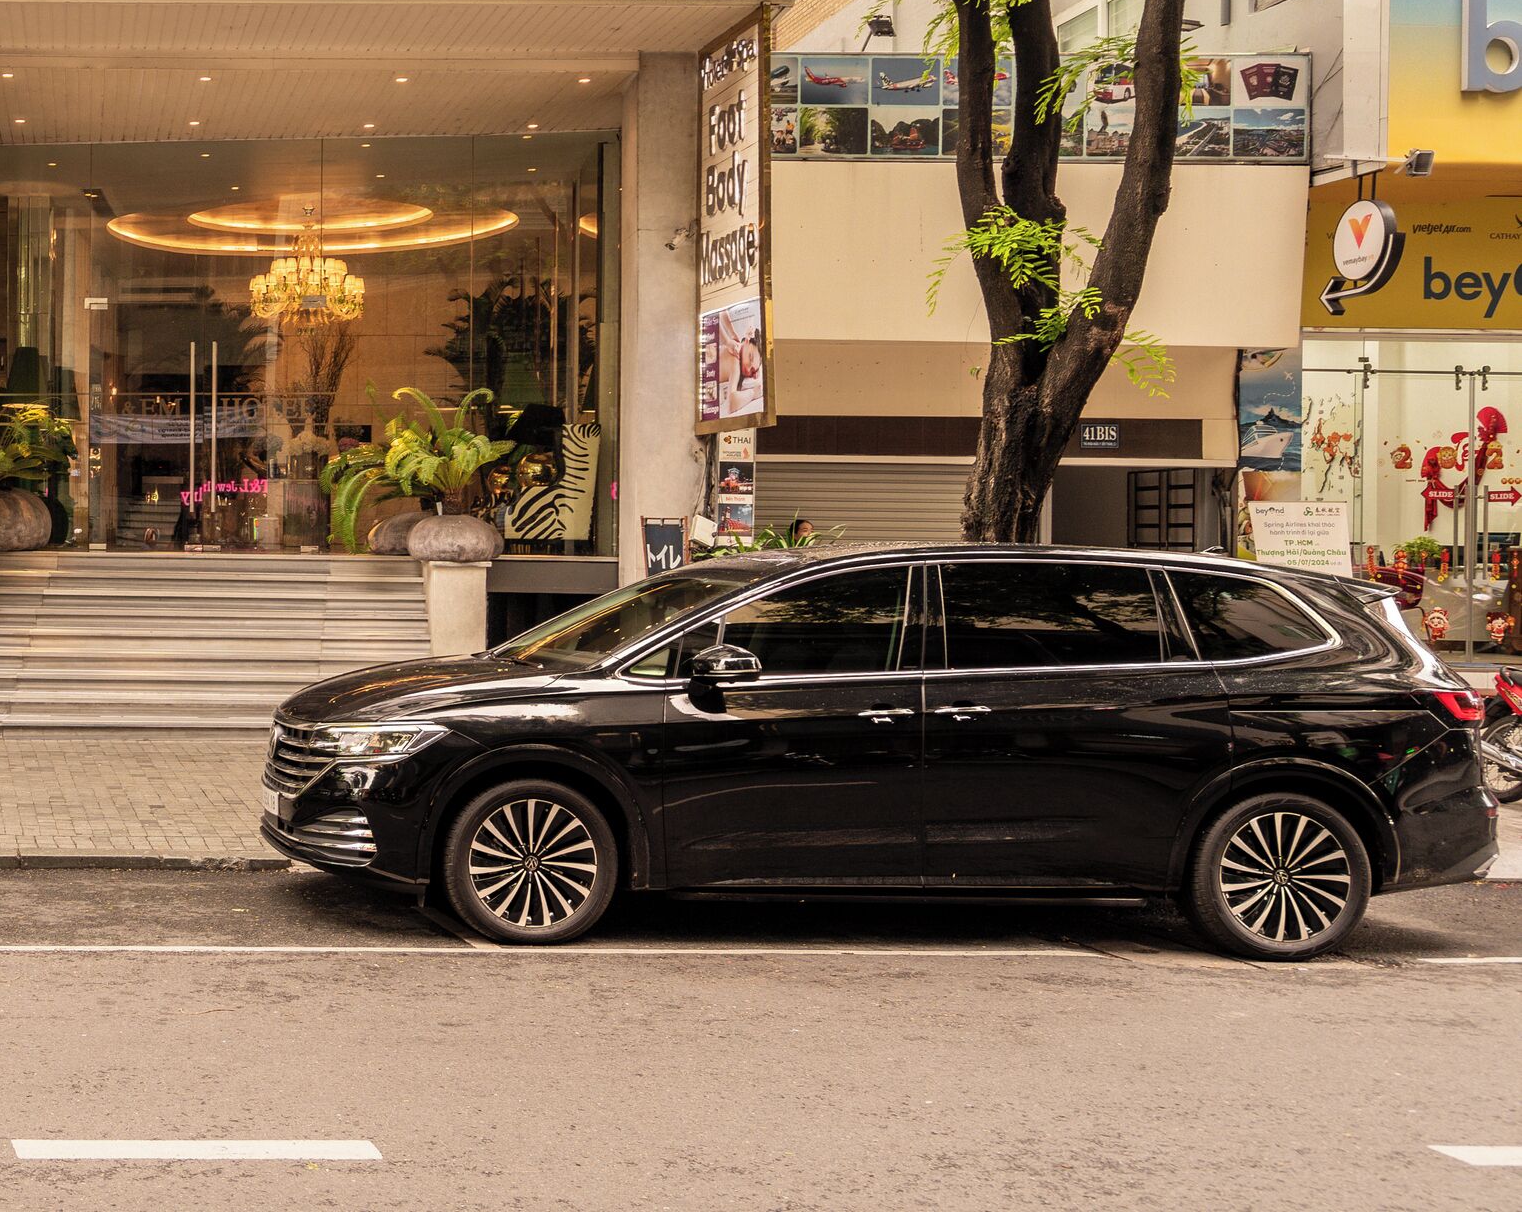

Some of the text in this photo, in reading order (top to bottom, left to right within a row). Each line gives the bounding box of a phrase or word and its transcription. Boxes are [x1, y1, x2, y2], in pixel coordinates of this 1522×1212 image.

[709, 88, 748, 157] Foot
[705, 149, 749, 218] Body
[700, 221, 759, 288] Massage
[733, 436, 751, 444] THAI
[1083, 426, 1117, 441] 41BIS
[1428, 490, 1454, 498] SLIDE
[646, 543, 682, 570] トイレ
